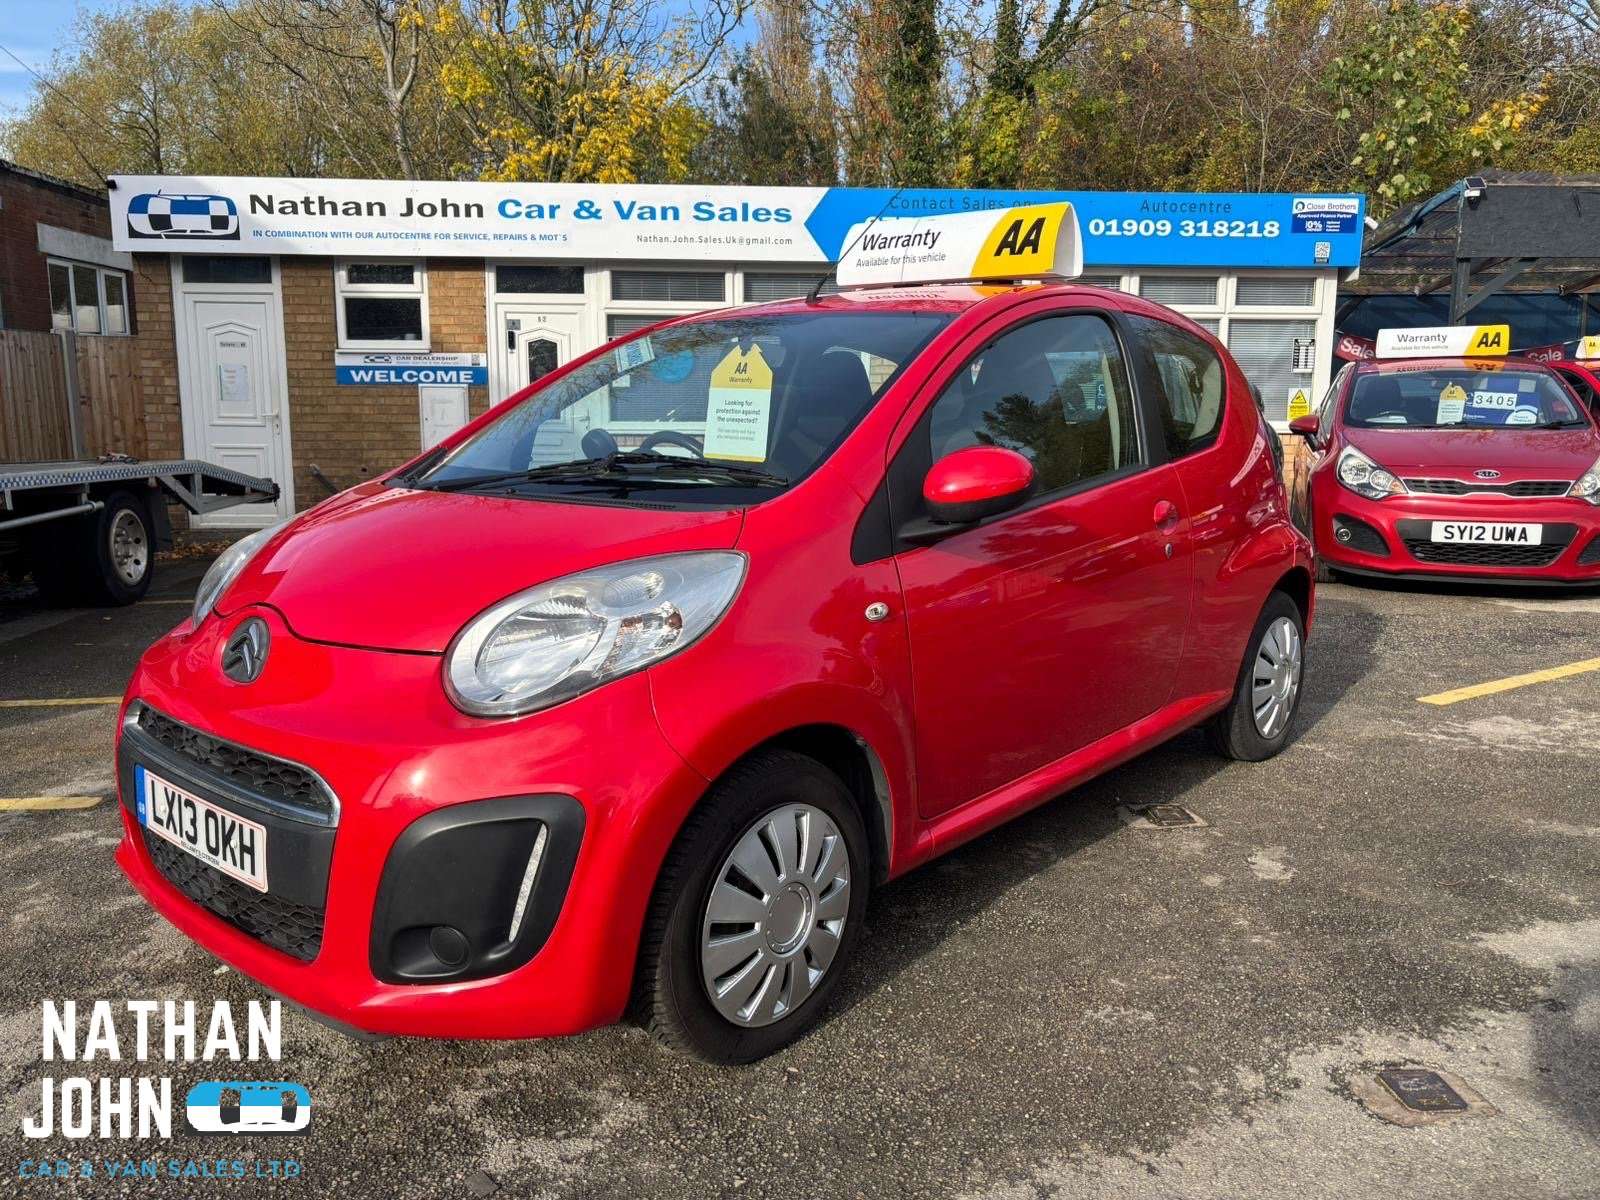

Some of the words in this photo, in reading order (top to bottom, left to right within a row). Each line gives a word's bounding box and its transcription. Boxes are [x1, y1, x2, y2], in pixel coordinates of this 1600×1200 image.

[249, 194, 387, 217] Nathan
[400, 197, 484, 218] John
[498, 198, 561, 219] Car
[573, 199, 602, 219] &
[613, 200, 680, 221] Van
[693, 201, 793, 223] Sales
[889, 196, 953, 210] Contact
[962, 197, 1005, 210] Sales
[1140, 200, 1232, 213] Autocentre
[265, 230, 328, 239] COMBINATION
[330, 231, 352, 239] WITH
[376, 232, 431, 240] AUTOCENTRE
[453, 233, 491, 241] SERVICE,
[493, 233, 528, 241] REPAIRS
[1088, 218, 1172, 236] 01909
[1179, 219, 1280, 238] 318218
[862, 228, 942, 251] Warranty
[994, 217, 1046, 257] AA
[856, 257, 889, 268] Available
[890, 256, 901, 266] for
[902, 255, 916, 265] this
[918, 252, 946, 264] vehicle
[1397, 333, 1448, 343] Warranty
[1477, 332, 1502, 348] AA
[1341, 337, 1374, 359] Sale
[350, 369, 474, 383] WELCOME
[734, 362, 748, 374] AA
[729, 376, 753, 384] Warranty
[1475, 395, 1514, 407] 3405
[1444, 525, 1486, 541] SY12
[1491, 526, 1528, 542] UWA
[151, 780, 198, 845] LX13
[204, 808, 256, 876] OKH
